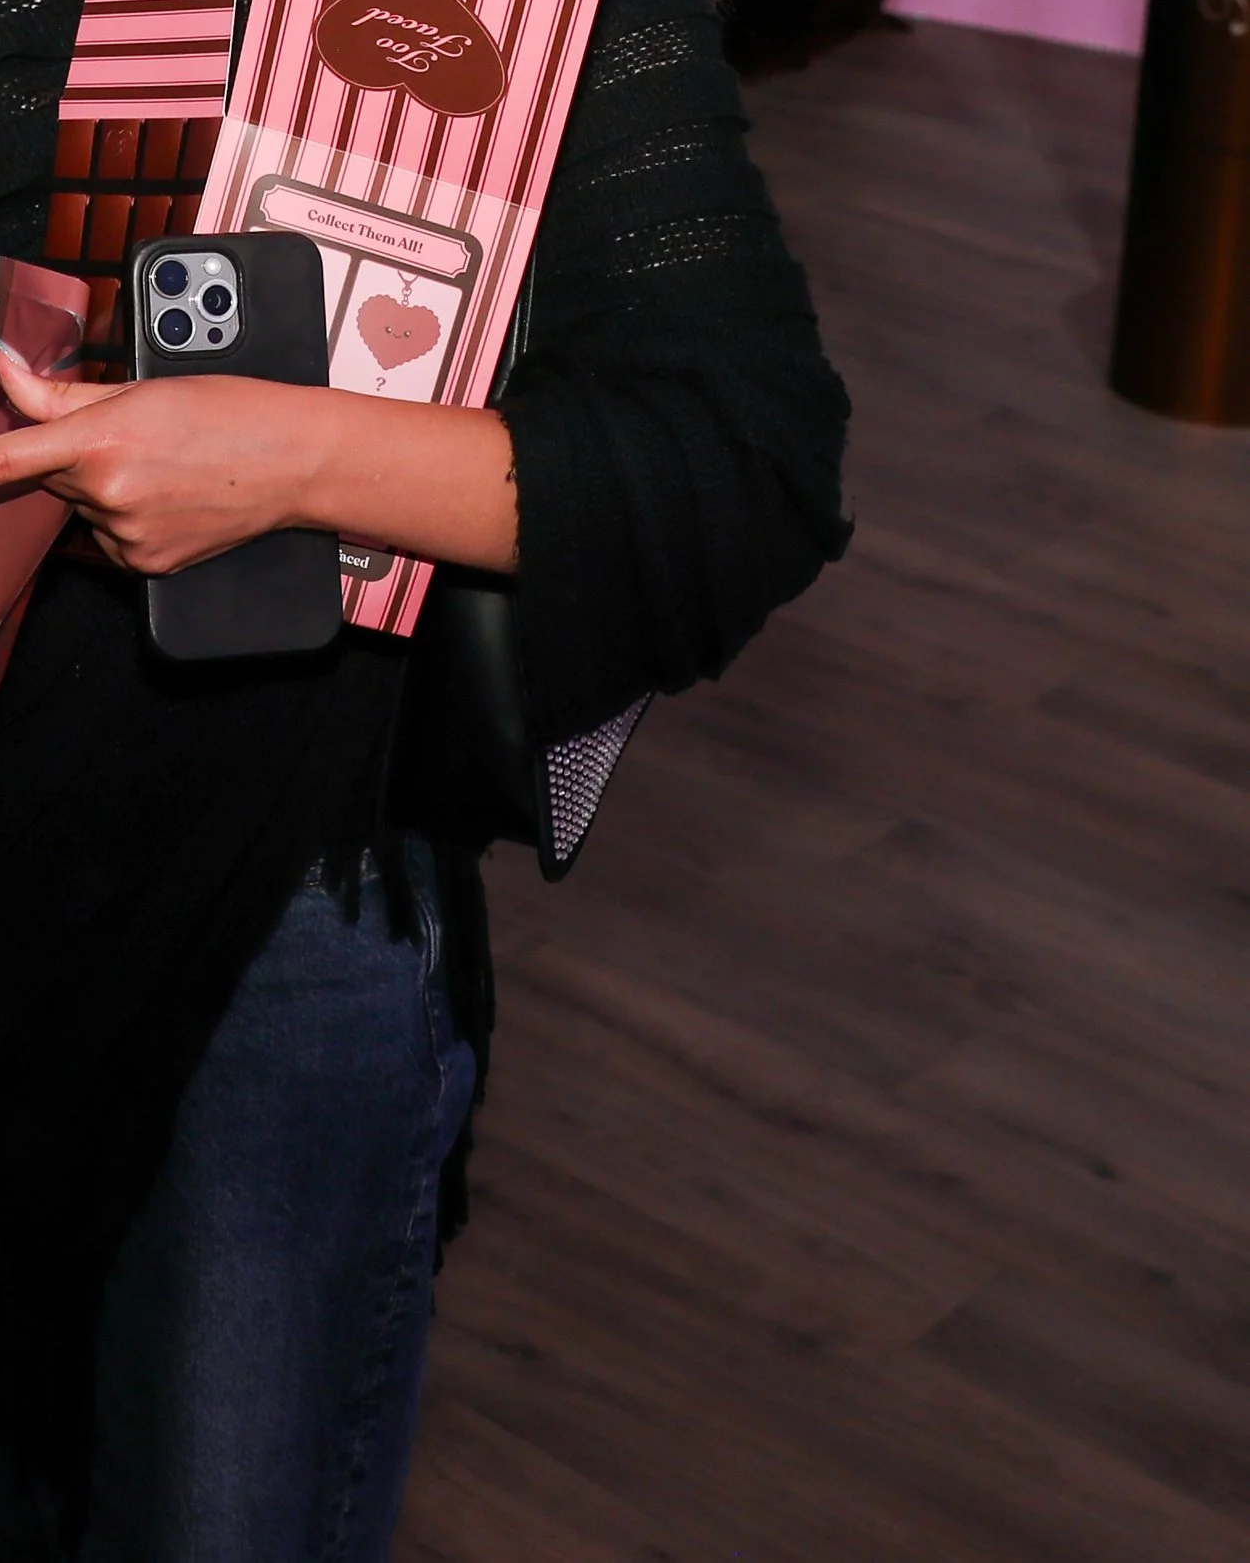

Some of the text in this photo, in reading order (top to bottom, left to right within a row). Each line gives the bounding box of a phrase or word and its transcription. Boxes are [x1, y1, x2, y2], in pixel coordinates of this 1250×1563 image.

[351, 7, 473, 58] Faced
[376, 38, 438, 72] Too
[307, 209, 424, 254] Collect Them All!
[339, 549, 371, 569] aced
